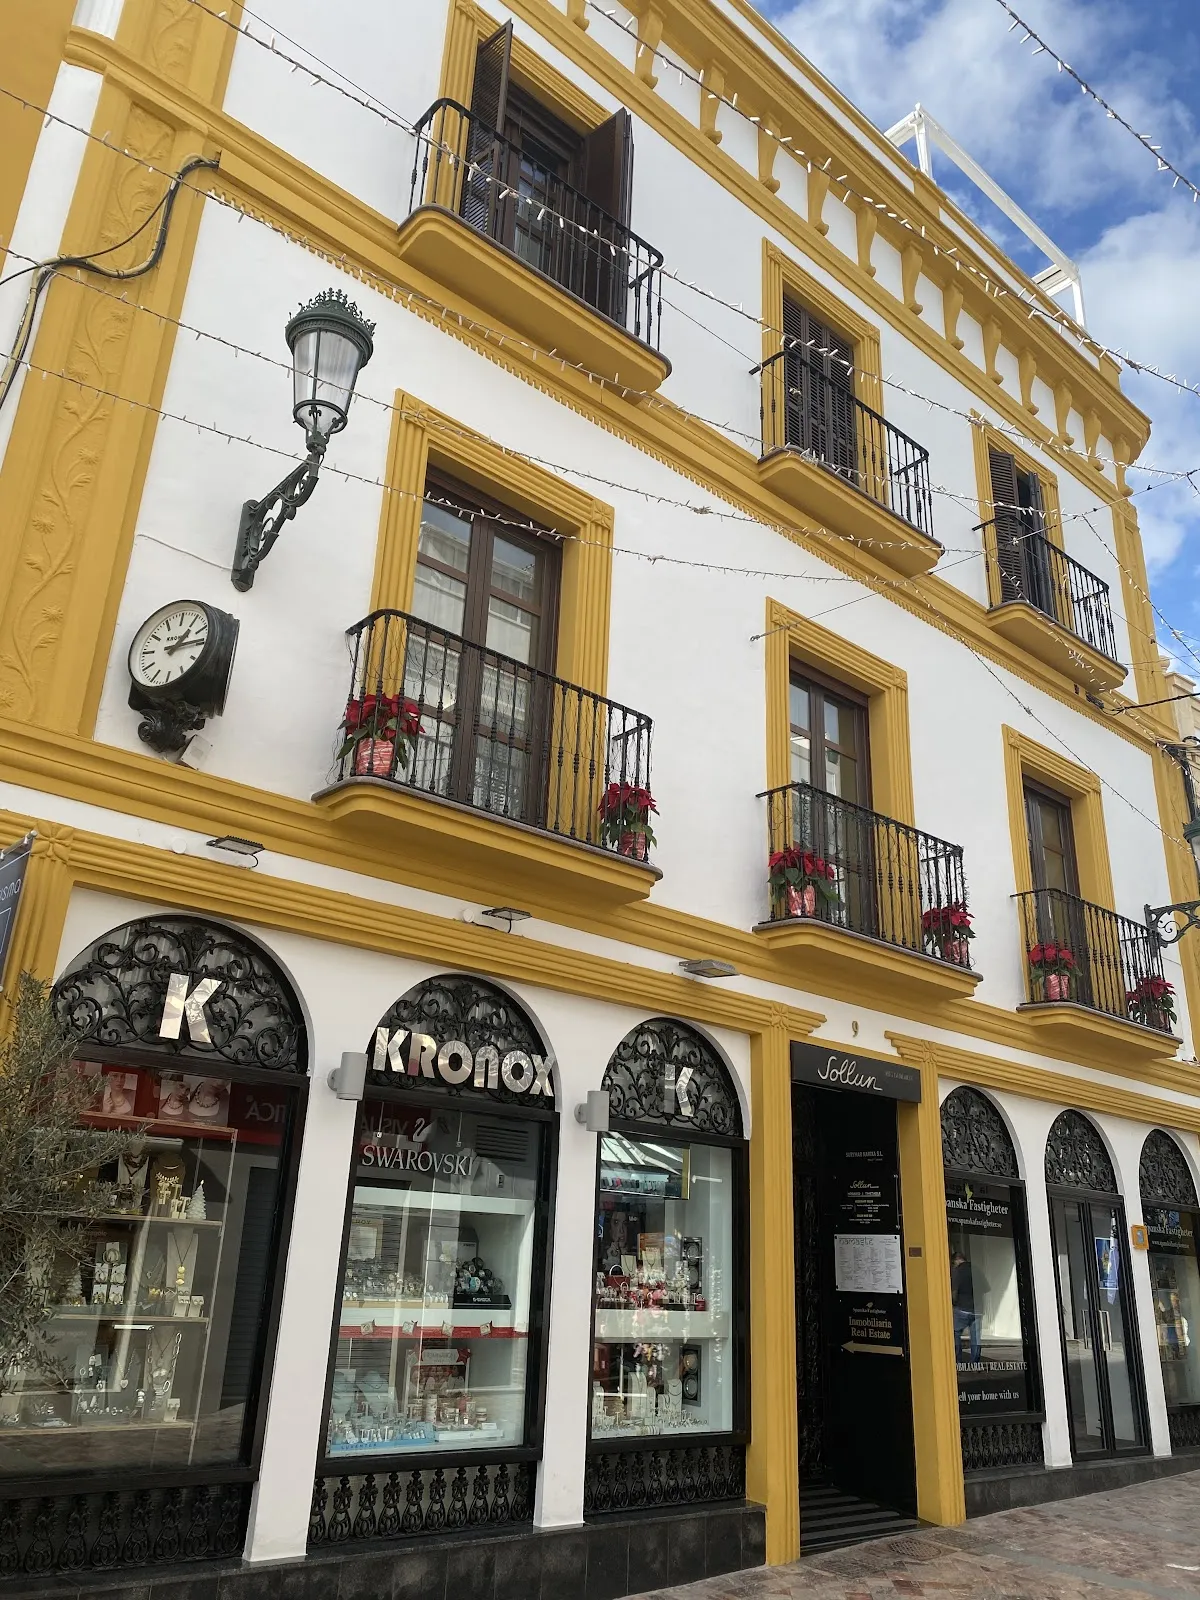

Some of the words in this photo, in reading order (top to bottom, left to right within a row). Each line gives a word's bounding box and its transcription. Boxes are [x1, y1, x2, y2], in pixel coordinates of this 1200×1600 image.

[159, 973, 222, 1044] K
[852, 1020, 859, 1038] 9
[373, 1027, 556, 1097] KRONOX
[817, 1055, 883, 1091] Sollun
[664, 1063, 694, 1117] K
[362, 1144, 474, 1176] SWAROVSKI
[968, 1199, 1008, 1216] Fastigheter
[848, 1316, 891, 1328] Inmobiliaria
[851, 1326, 866, 1337] Real
[868, 1328, 890, 1339] Estate
[989, 1361, 1005, 1370] REAL
[1006, 1361, 1027, 1370] ESTATE
[958, 1391, 966, 1401] ell
[967, 1393, 980, 1404] your
[981, 1390, 997, 1400] home
[998, 1389, 1011, 1399] with
[1012, 1391, 1020, 1399] us
